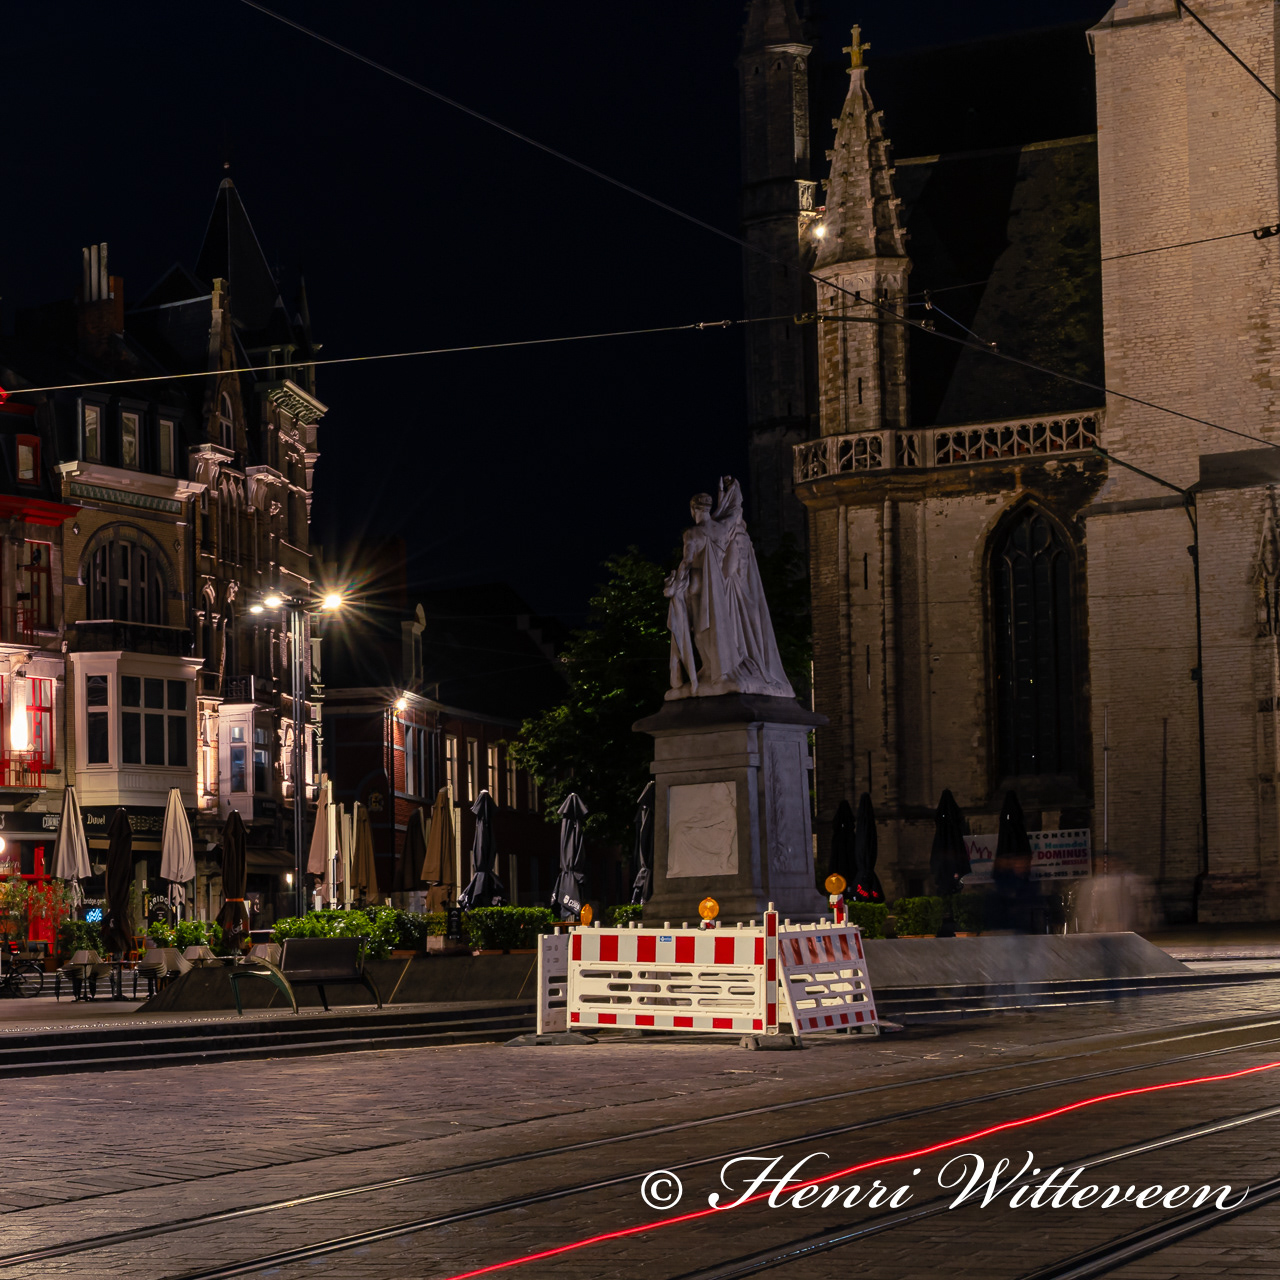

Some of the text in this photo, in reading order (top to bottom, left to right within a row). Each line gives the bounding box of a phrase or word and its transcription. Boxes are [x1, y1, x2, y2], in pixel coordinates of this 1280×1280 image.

[42, 816, 60, 827] CORNE
[87, 813, 106, 825] Duvel
[1037, 849, 1088, 860] DOMINUS
